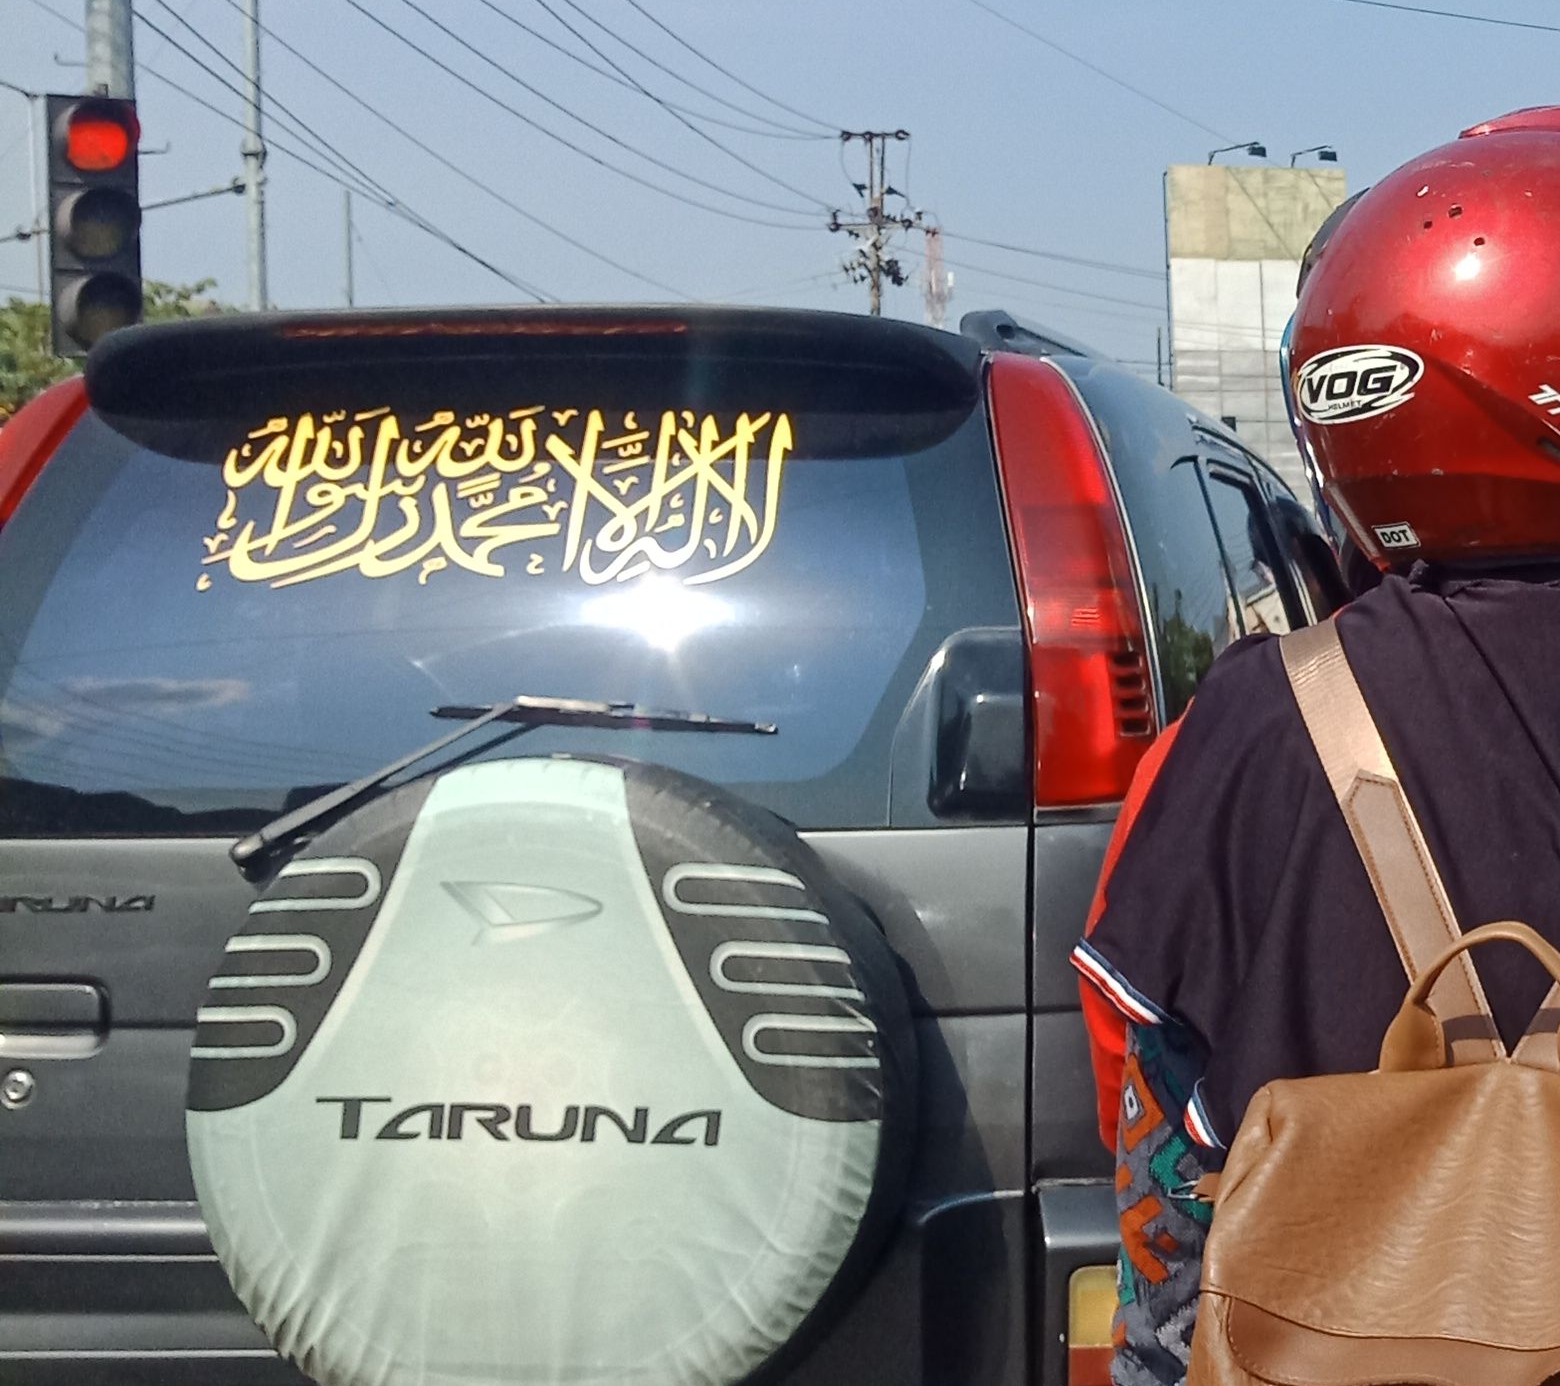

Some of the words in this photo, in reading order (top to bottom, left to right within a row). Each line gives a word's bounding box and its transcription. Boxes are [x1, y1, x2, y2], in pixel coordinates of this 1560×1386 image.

[1307, 364, 1397, 405] VOG
[1380, 529, 1410, 544] DOT
[315, 1096, 723, 1147] TARUNA
